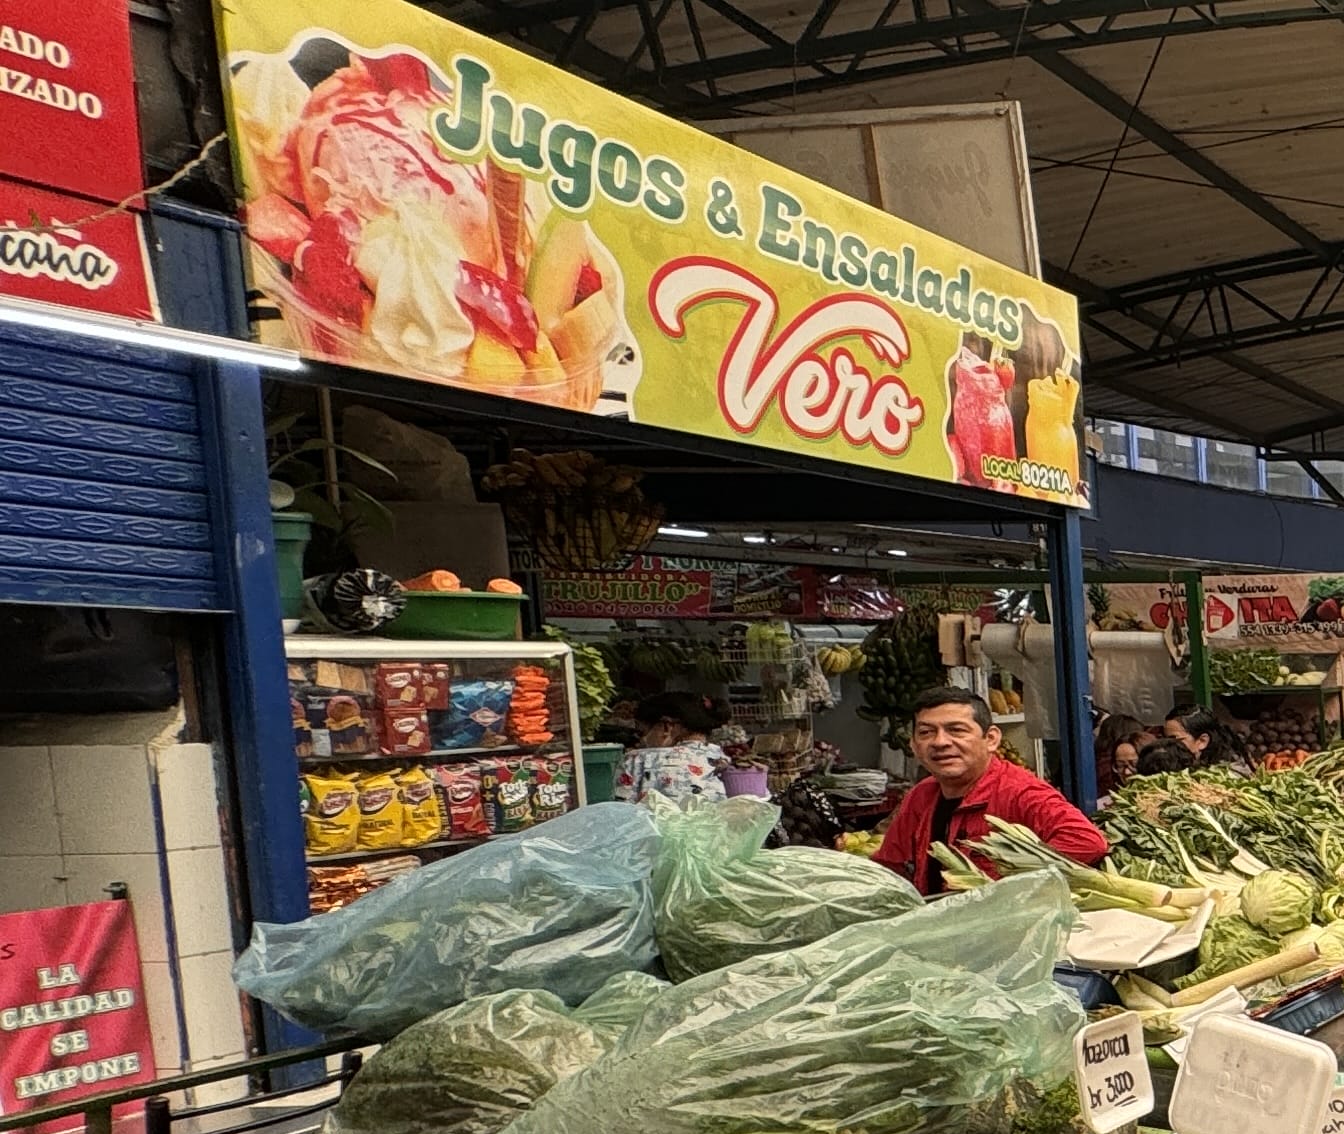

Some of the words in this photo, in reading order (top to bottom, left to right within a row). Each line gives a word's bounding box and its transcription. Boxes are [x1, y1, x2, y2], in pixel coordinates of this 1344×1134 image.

[436, 58, 685, 223] Jugos
[705, 178, 745, 237] &
[758, 184, 1022, 343] Ensaladas
[648, 255, 923, 452] Vero
[982, 457, 1020, 481] LOCAL
[1021, 459, 1073, 495] 80211A
[1217, 583, 1279, 599] Verduras
[37, 963, 80, 990] LA
[1, 988, 134, 1031] CALIDAD
[51, 1030, 89, 1056] SE
[15, 1052, 141, 1099] IMPONE
